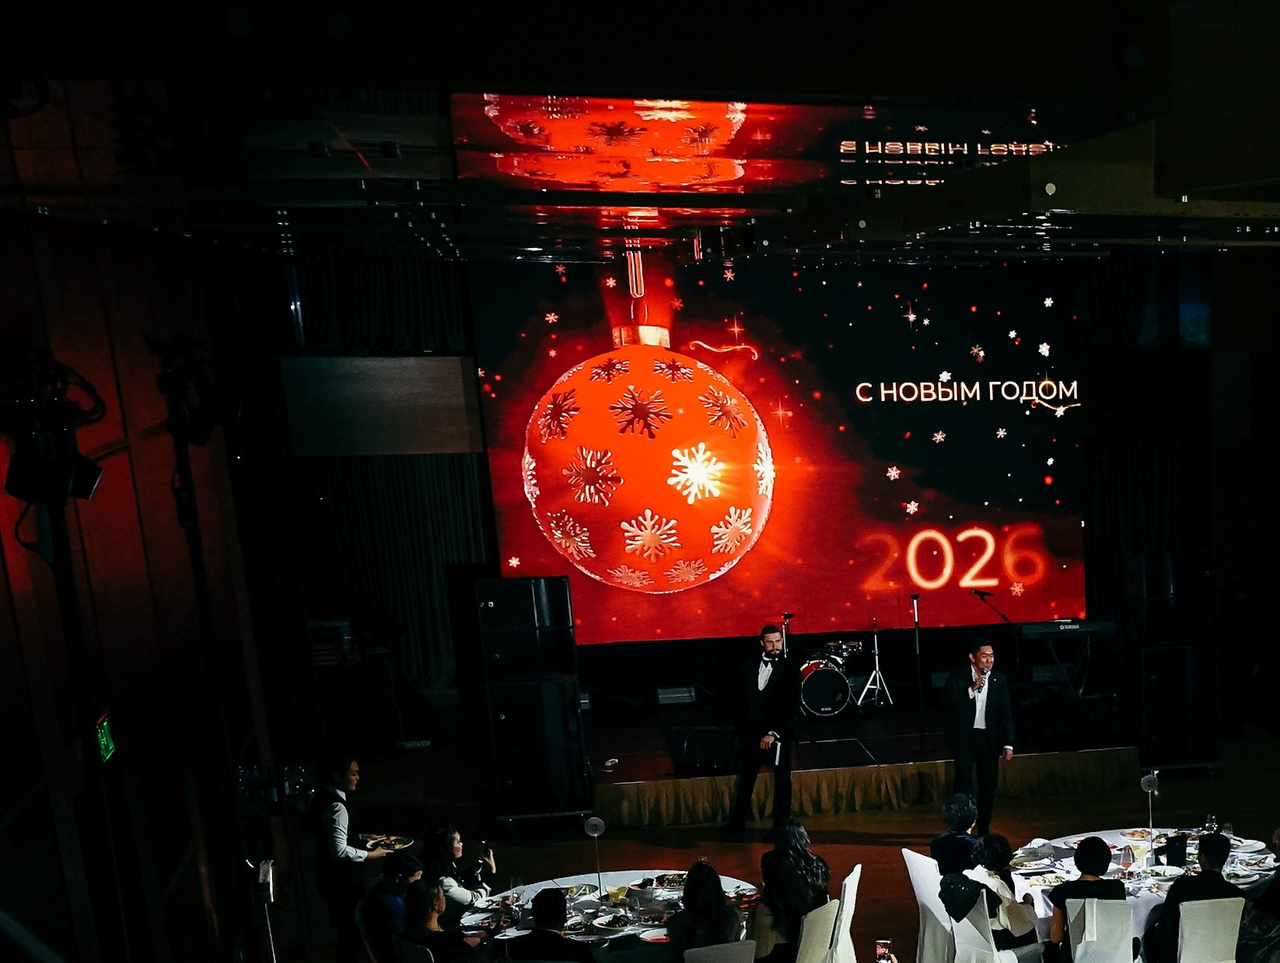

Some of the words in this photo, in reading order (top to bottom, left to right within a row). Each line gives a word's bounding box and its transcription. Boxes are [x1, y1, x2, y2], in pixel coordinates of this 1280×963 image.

[855, 382, 873, 402] С
[880, 381, 981, 402] НОВЫМ
[989, 380, 1078, 404] ГОДОМ
[855, 526, 1046, 592] 2026
